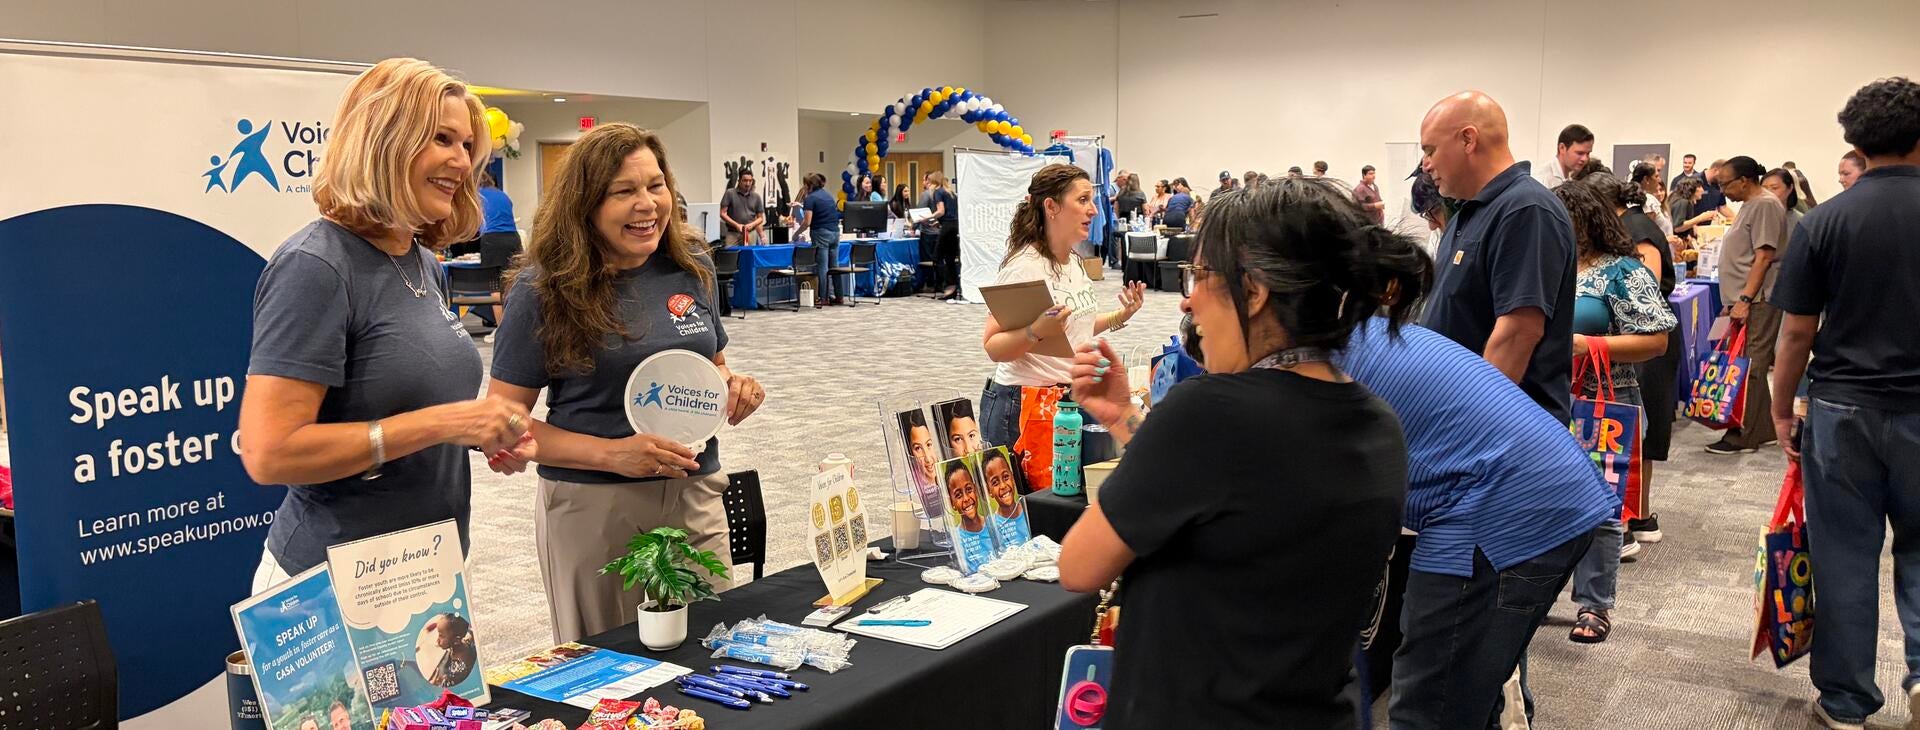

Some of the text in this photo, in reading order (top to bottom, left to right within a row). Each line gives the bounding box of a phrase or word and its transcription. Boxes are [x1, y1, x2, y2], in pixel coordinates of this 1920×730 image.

[1699, 360, 1740, 387] YOUR
[68, 374, 235, 430] Speak up
[665, 395, 718, 412] Children
[668, 384, 719, 400] Voices for
[1691, 380, 1732, 403] LOCAL
[1685, 397, 1729, 421] STORE
[73, 453, 96, 484] a
[108, 431, 219, 477] foster
[78, 491, 225, 538] Learn more at
[354, 557, 377, 579] Did
[379, 557, 399, 576] you
[276, 615, 318, 647] SPEAK UP
[262, 661, 272, 675] for
[277, 647, 294, 666] youth
[300, 636, 317, 653] foster
[275, 663, 296, 681] CASA
[295, 639, 336, 669] VOLUNTEER!
